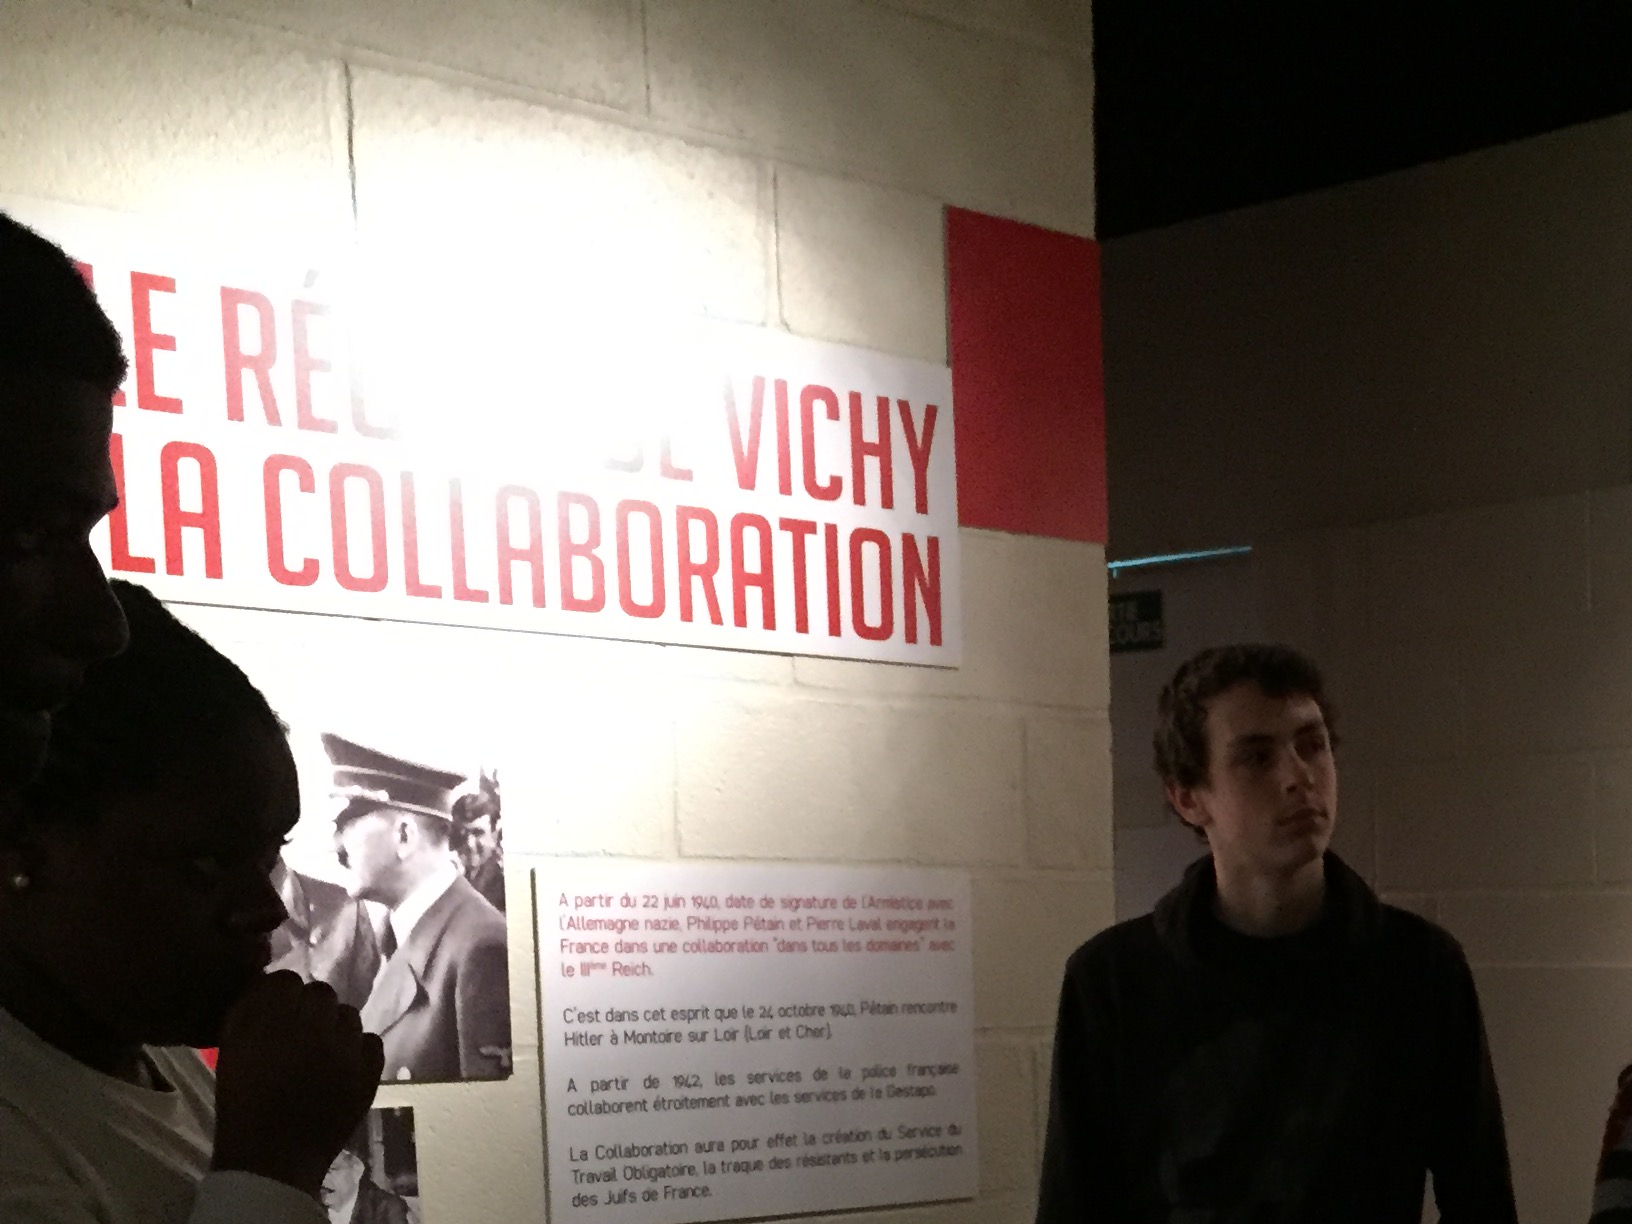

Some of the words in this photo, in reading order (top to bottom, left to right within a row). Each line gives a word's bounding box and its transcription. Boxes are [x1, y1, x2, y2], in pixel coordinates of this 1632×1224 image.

[723, 374, 938, 515] VICHY
[108, 433, 223, 579] LA
[263, 453, 942, 647] COLLABORATION
[559, 893, 568, 907] A
[575, 894, 614, 910] partir
[620, 894, 637, 909] du
[643, 895, 659, 908] 22
[664, 895, 685, 911] juin
[692, 895, 720, 909] 1940,
[726, 894, 754, 909] date
[760, 895, 774, 909] de
[781, 896, 837, 912] signature
[843, 896, 856, 909] de
[559, 916, 638, 934] l'Allemagne
[645, 918, 682, 932] nazie,
[687, 916, 738, 934] Philippe
[744, 915, 784, 931] Pétain
[790, 918, 802, 930] et
[807, 916, 844, 931] Pierre
[850, 918, 882, 931] Laval
[560, 939, 608, 954] France
[615, 940, 647, 953] dans
[653, 942, 677, 953] une
[683, 940, 768, 953] collaboration
[812, 939, 838, 952] tous
[843, 939, 860, 952] les
[562, 963, 574, 977] le
[612, 962, 653, 977] Reich.
[563, 1008, 601, 1024] C'est
[606, 1008, 638, 1022] dans
[644, 1008, 665, 1022] cet
[671, 1005, 709, 1024] esprit
[714, 1008, 737, 1023] que
[743, 1005, 754, 1019] le
[759, 1005, 774, 1019] 24
[778, 1003, 825, 1018] octobre
[860, 1001, 898, 1014] Pétain
[901, 1001, 957, 1014] rencontre
[565, 1031, 603, 1047] Hitler
[610, 1029, 618, 1045] à
[624, 1029, 682, 1045] Montoire
[688, 1030, 709, 1043] sur
[714, 1027, 738, 1042] Loir
[744, 1025, 772, 1043] (Loir
[778, 1026, 791, 1040] et
[568, 1078, 577, 1092] A
[591, 1076, 629, 1093] partir
[644, 1075, 659, 1089] de
[673, 1075, 703, 1089] 1942,
[715, 1072, 735, 1086] les
[747, 1070, 802, 1085] services
[813, 1067, 828, 1081] de
[838, 1067, 851, 1080] la
[862, 1064, 896, 1082] police
[568, 1099, 648, 1117] collaborent
[653, 1094, 730, 1111] étroitement
[735, 1094, 764, 1107] avec
[769, 1091, 789, 1105] les
[794, 1089, 847, 1103] services
[851, 1087, 865, 1100] de
[870, 1086, 882, 1098] la
[570, 1147, 588, 1162] La
[595, 1141, 688, 1160] Collaboration
[695, 1140, 724, 1154] aura
[731, 1137, 759, 1153] pour
[767, 1133, 797, 1149] effet
[803, 1132, 816, 1146] la
[822, 1129, 872, 1144] création
[878, 1128, 892, 1140] du
[897, 1125, 942, 1139] Service
[948, 1123, 962, 1136] du
[572, 1168, 617, 1184] Travail
[704, 1161, 716, 1175] la
[721, 1159, 763, 1175] traque
[769, 1156, 791, 1169] des
[797, 1152, 857, 1168] résistants
[862, 1150, 875, 1163] et
[879, 1149, 890, 1162] la
[572, 1193, 598, 1207] des
[604, 1189, 637, 1205] Juifs
[642, 1188, 658, 1202] de
[664, 1185, 712, 1199] France.
